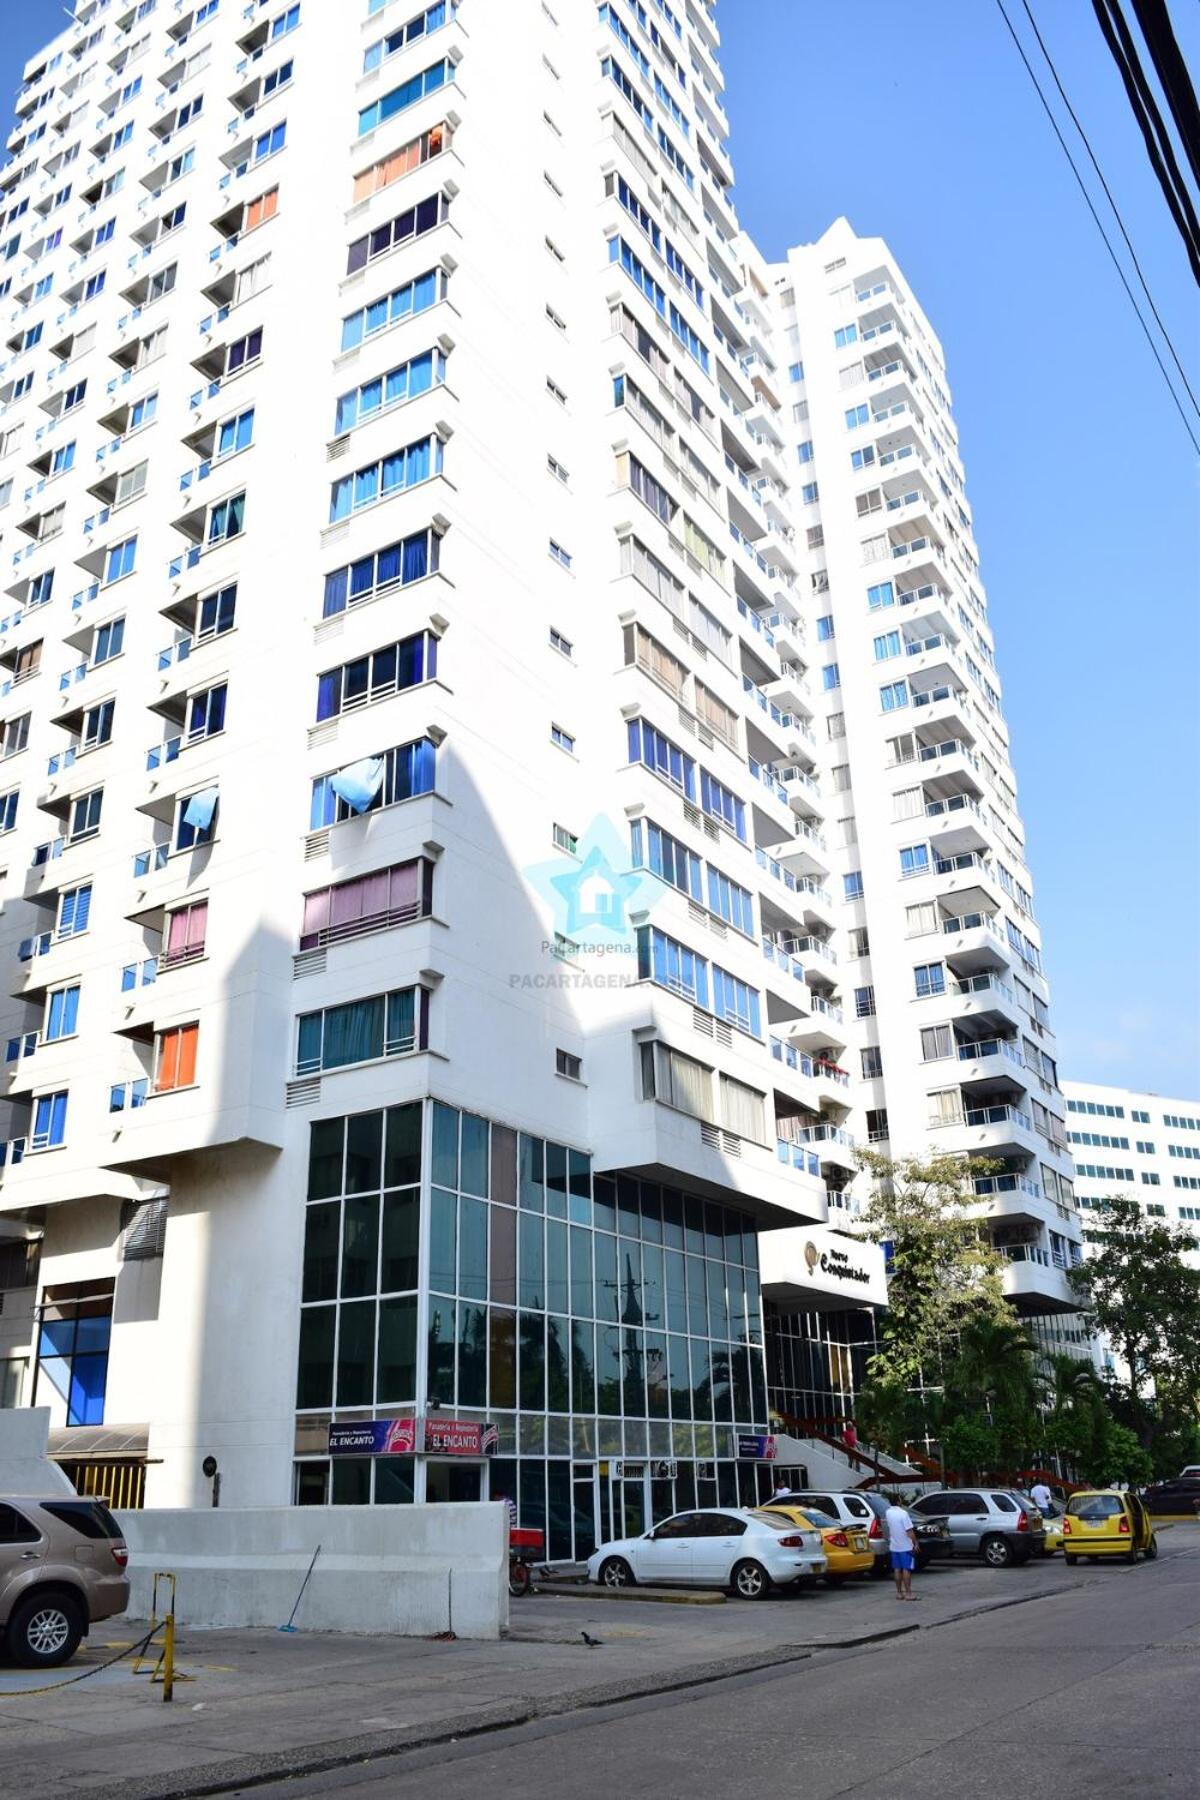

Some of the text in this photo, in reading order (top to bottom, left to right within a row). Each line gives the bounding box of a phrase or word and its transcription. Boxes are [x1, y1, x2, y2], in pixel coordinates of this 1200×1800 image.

[329, 1435, 375, 1447] EL ENCANTO
[432, 1434, 441, 1447] EL
[443, 1434, 477, 1449] ENCANTO
